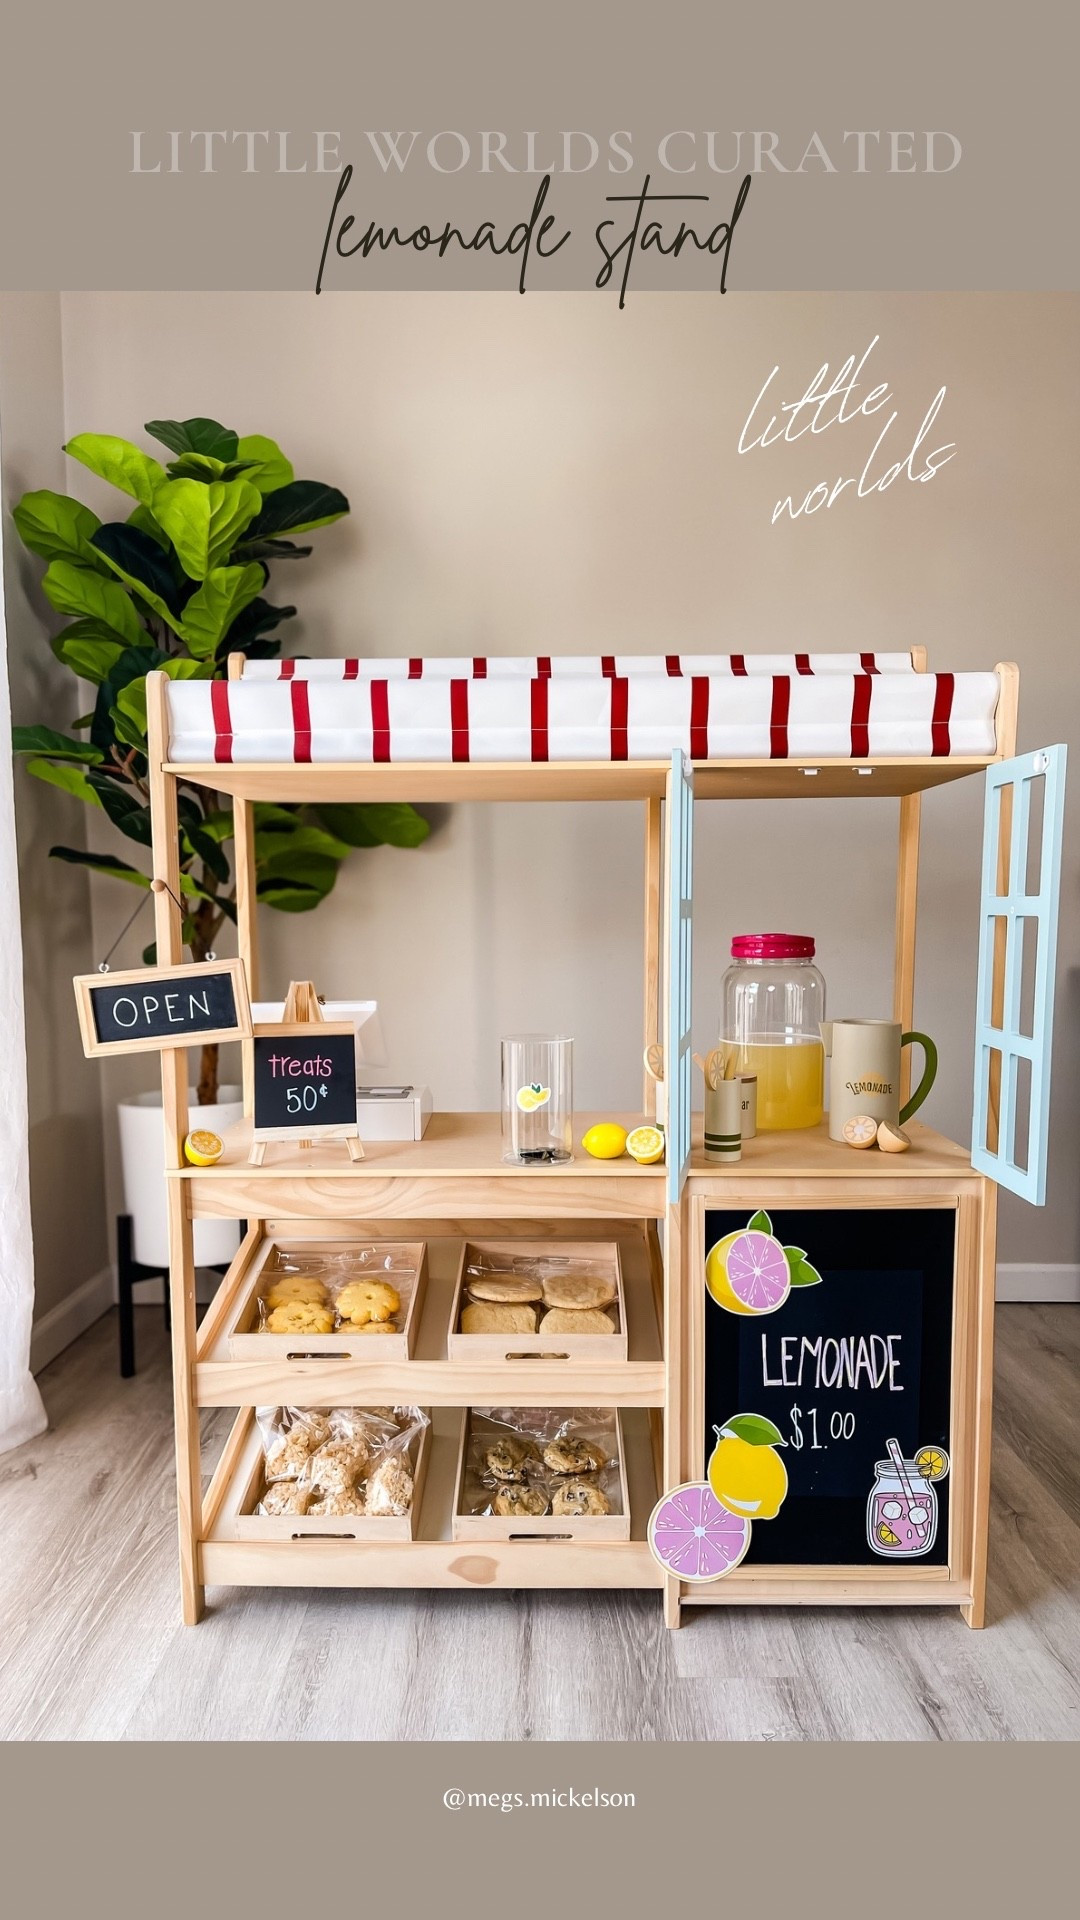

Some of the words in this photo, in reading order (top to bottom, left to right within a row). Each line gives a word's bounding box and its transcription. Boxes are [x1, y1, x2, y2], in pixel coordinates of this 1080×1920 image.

[112, 989, 211, 1028] OPEN
[267, 1054, 333, 1078] treats
[286, 1083, 329, 1114] 50¢
[845, 1081, 893, 1096] LEMONADE
[761, 1333, 905, 1392] LEMONADE
[789, 1402, 856, 1452] $1.00
